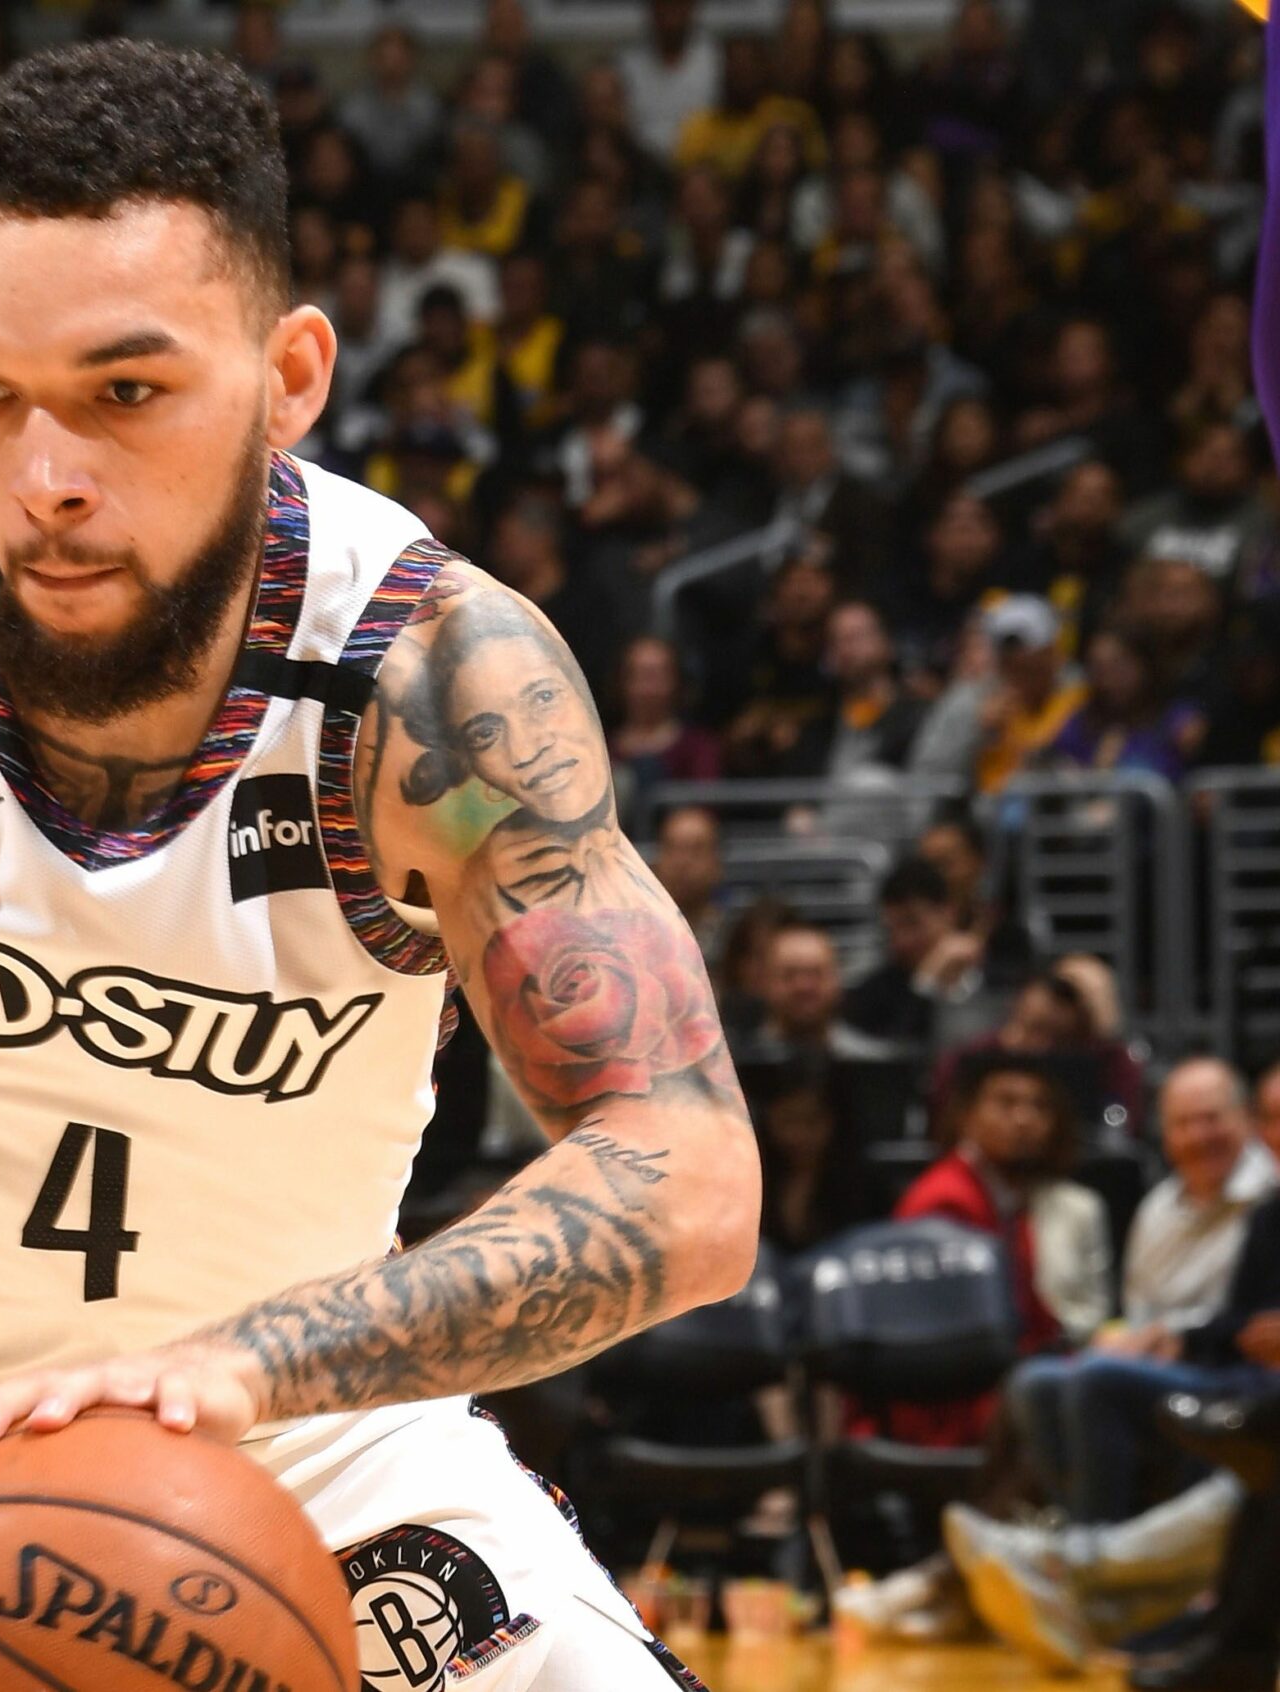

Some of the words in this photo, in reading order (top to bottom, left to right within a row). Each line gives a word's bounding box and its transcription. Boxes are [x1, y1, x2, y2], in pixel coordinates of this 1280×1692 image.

[229, 808, 314, 859] infor
[21, 1121, 141, 1304] 4
[348, 1546, 457, 1583] OKLYN
[368, 1590, 438, 1689] B
